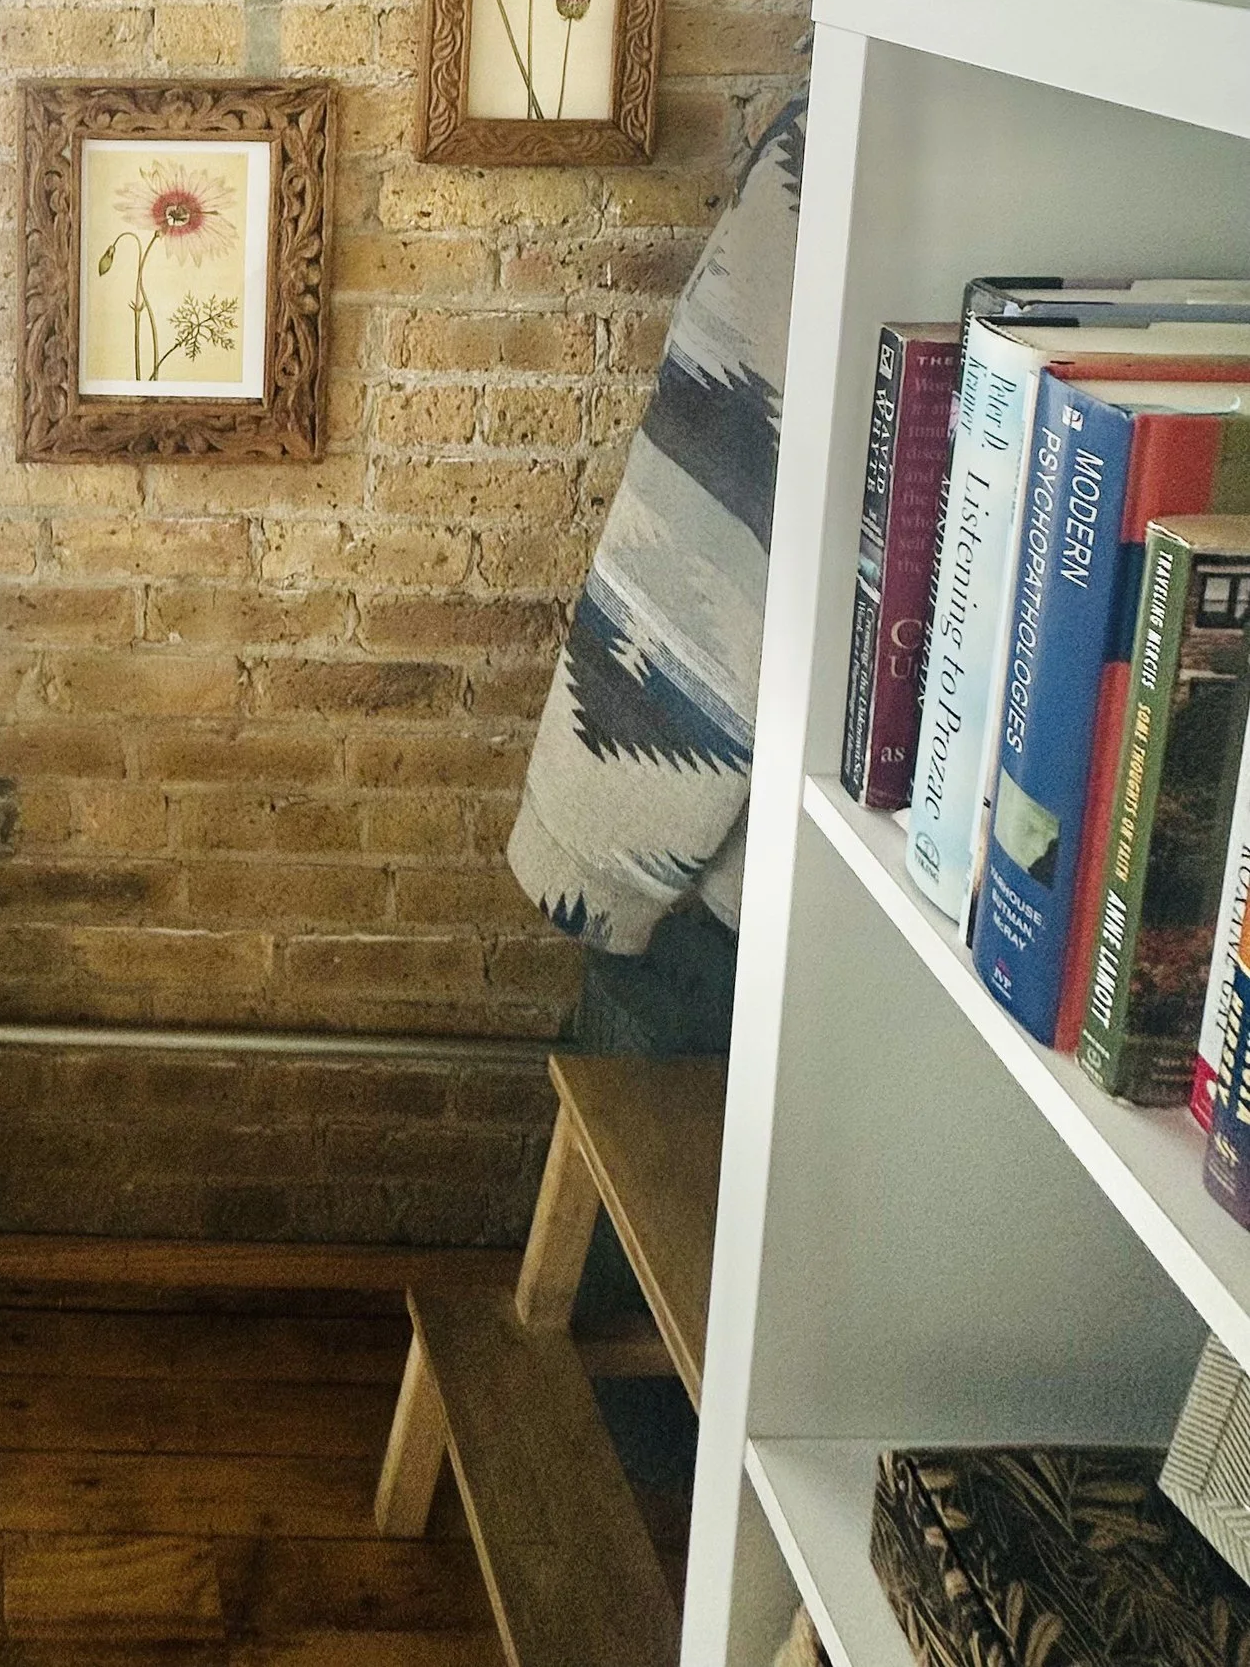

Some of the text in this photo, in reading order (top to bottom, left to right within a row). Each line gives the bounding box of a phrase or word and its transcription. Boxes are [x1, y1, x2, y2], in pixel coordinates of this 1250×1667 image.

[917, 355, 955, 367] THE
[960, 356, 988, 436] Kramer
[866, 389, 887, 493] WHYTE
[876, 395, 895, 494] DAVID
[981, 372, 1017, 451] Peter D.
[1060, 447, 1105, 590] MODERN
[1006, 426, 1062, 754] PSYCHOPATHOLOGIES
[1141, 550, 1174, 691] TRAVELING MERCIES
[925, 470, 991, 820] Listening to Prozac
[881, 746, 906, 763] as
[1115, 701, 1151, 883] SOME THOUGHTS ON FAITH
[1103, 888, 1127, 951] ANNE
[1091, 945, 1120, 1030] LAMOTT
